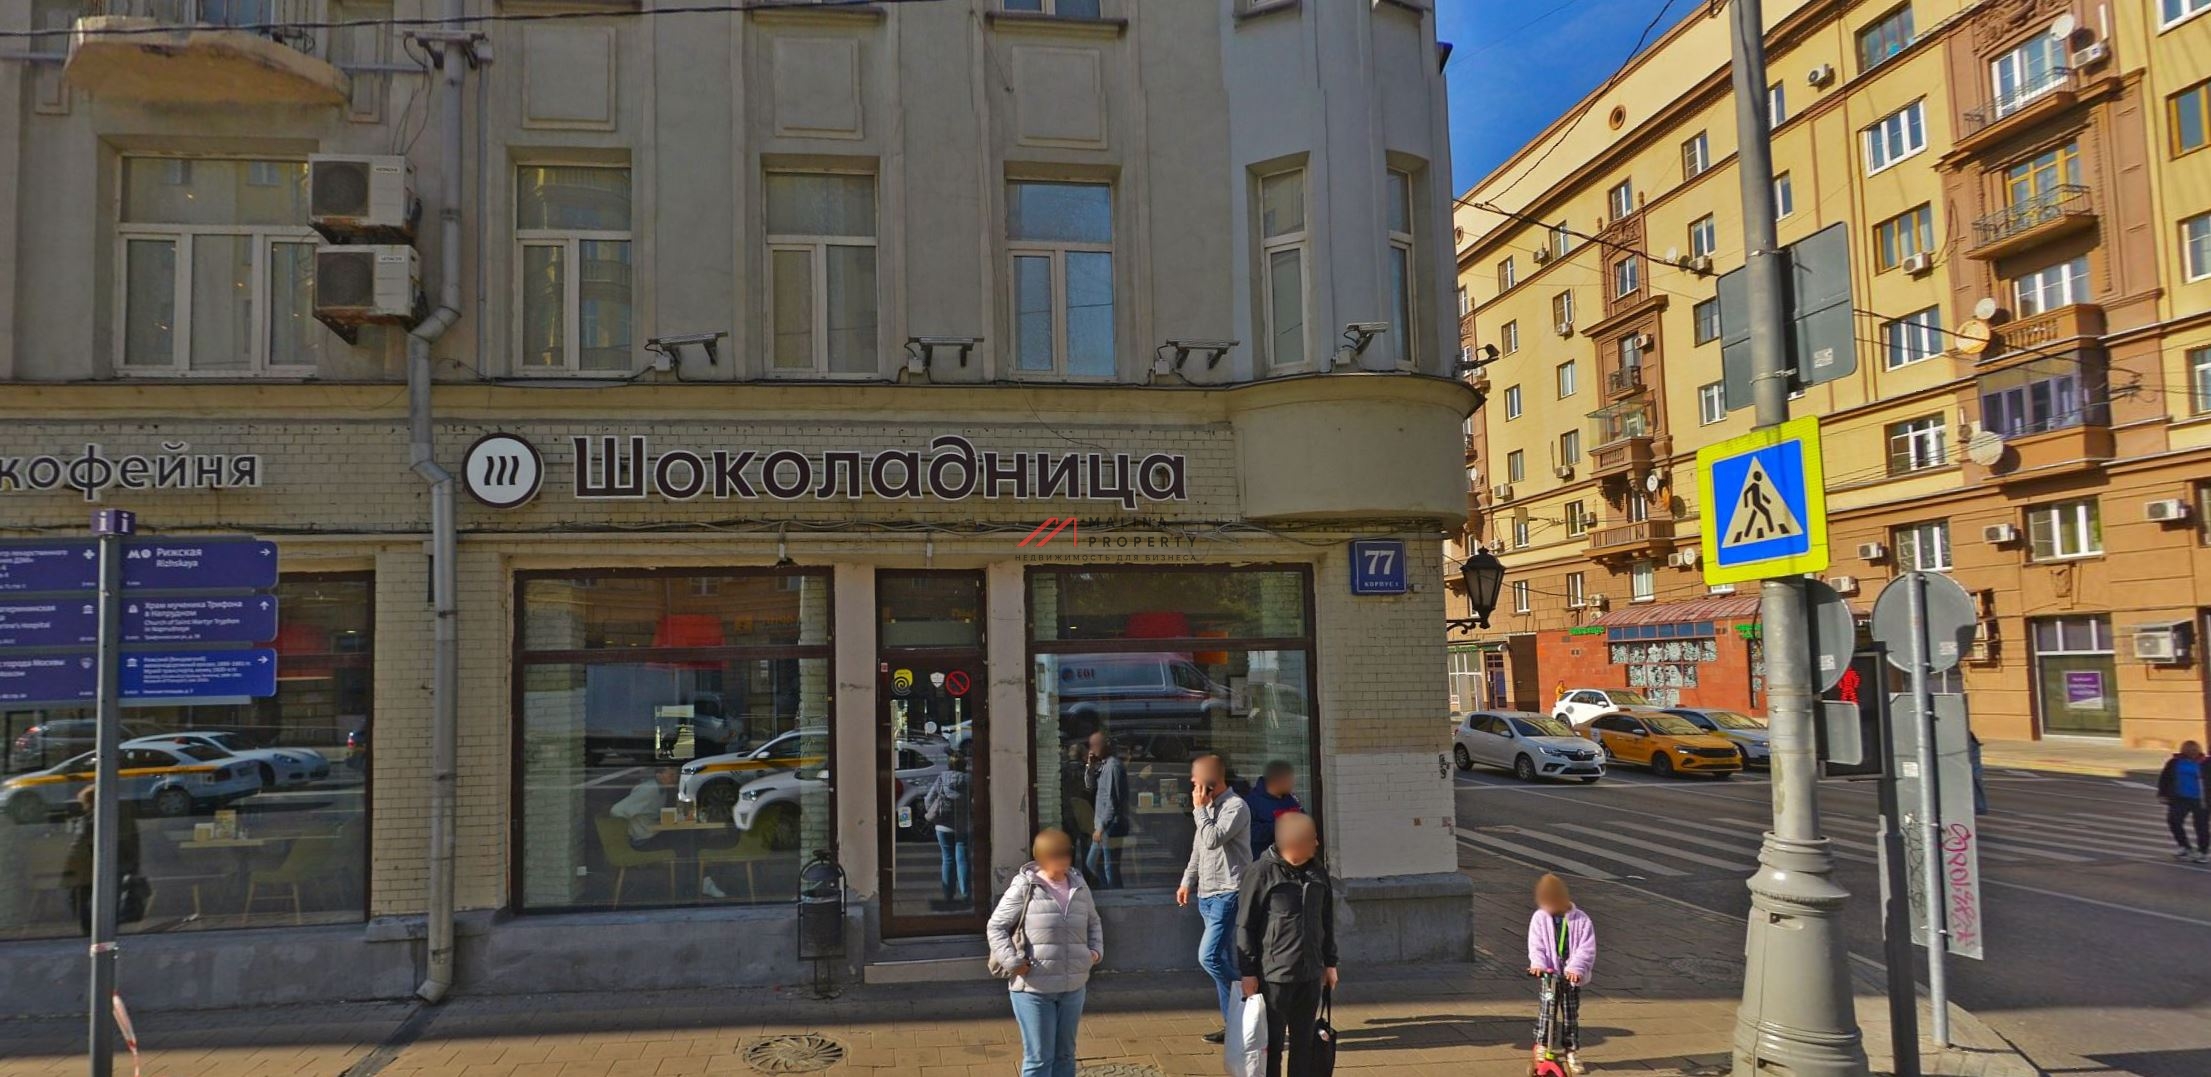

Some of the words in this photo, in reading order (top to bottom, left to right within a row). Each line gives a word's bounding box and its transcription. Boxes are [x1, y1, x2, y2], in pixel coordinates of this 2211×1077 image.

[0, 442, 259, 501] кофейня
[571, 435, 1187, 510] Шоколадница
[156, 547, 203, 557] Рижская
[1364, 550, 1395, 575] 77
